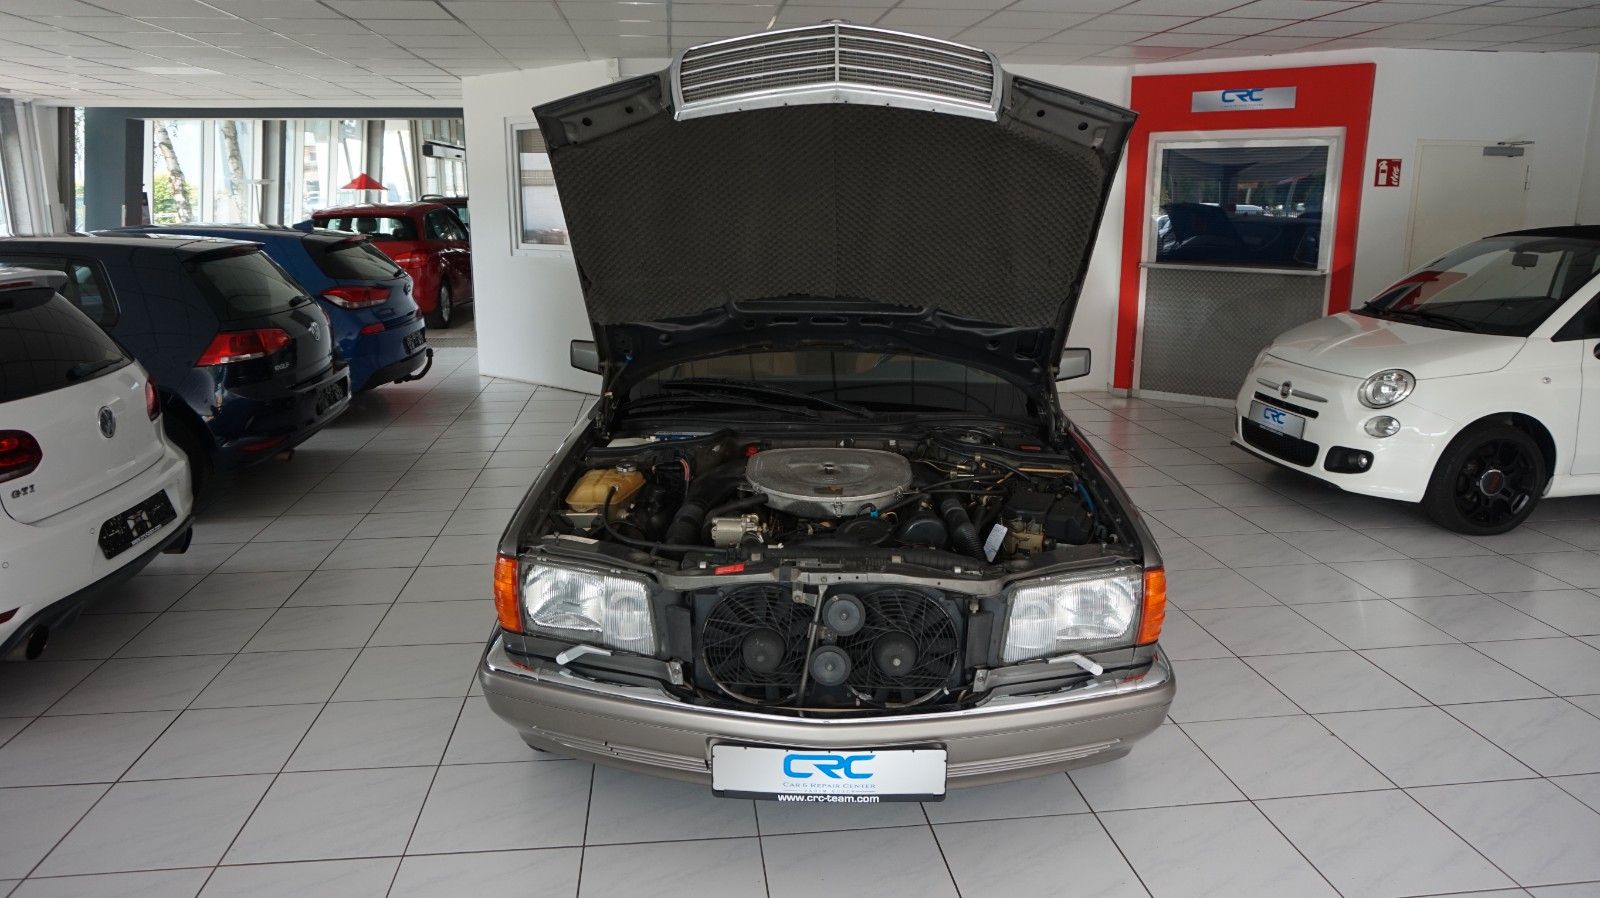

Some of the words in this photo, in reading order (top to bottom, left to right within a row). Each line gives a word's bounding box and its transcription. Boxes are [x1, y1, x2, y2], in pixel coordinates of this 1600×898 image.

[1221, 88, 1265, 103] CRC
[1263, 407, 1287, 425] CRC
[11, 484, 35, 499] GTI
[783, 753, 876, 779] CRC
[777, 794, 880, 803] www.crc-team.com
